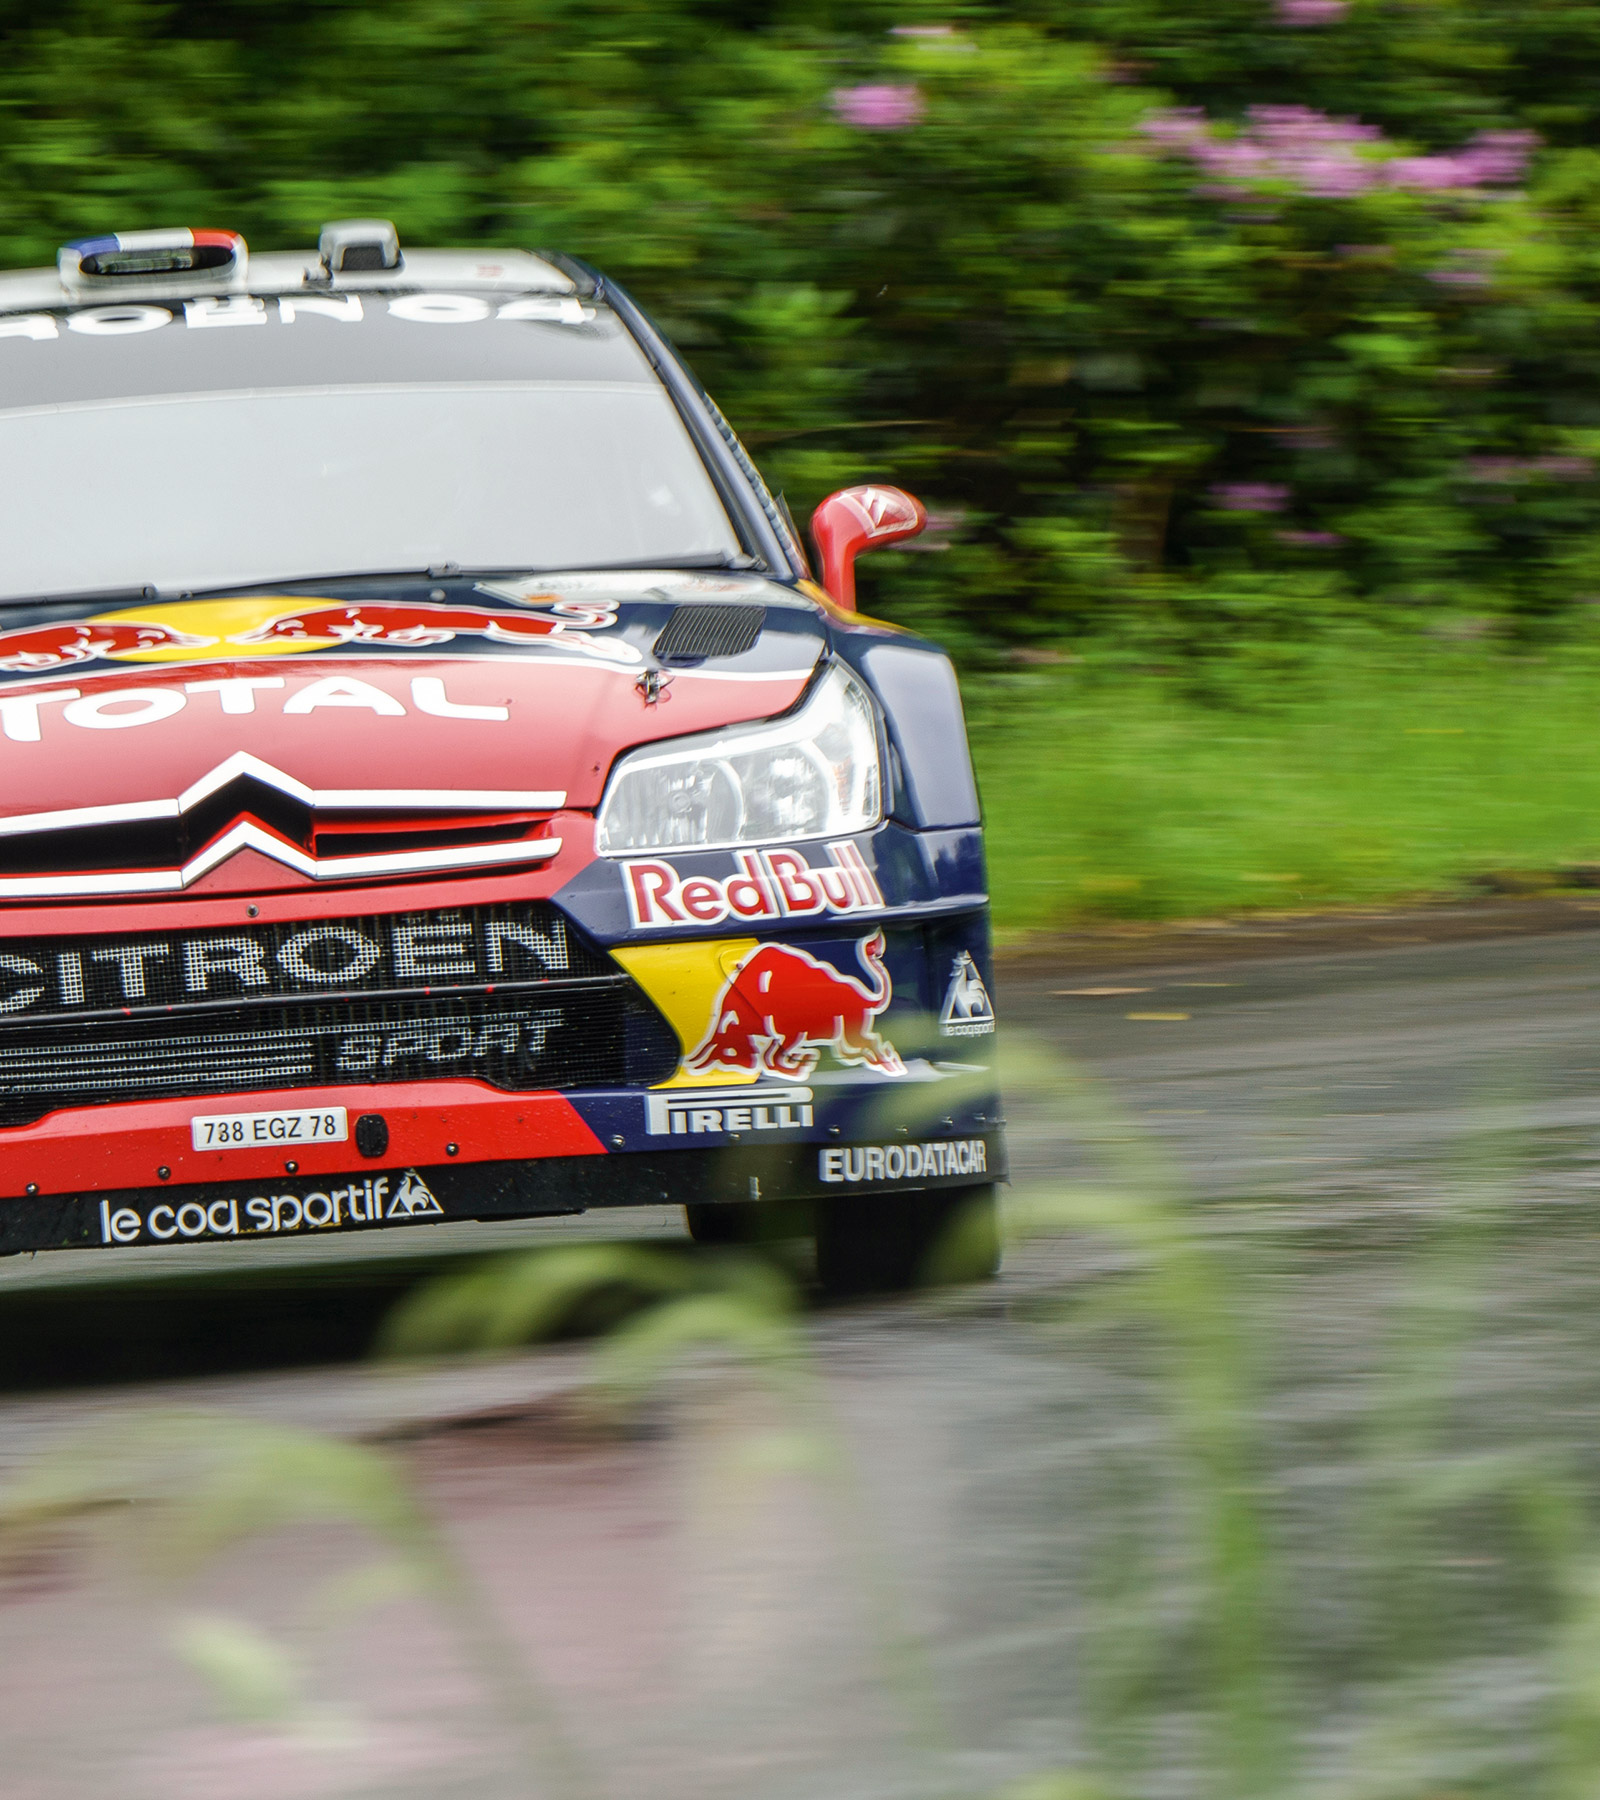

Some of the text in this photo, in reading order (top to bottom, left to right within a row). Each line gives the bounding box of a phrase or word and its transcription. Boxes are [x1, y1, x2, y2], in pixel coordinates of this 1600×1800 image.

[387, 293, 597, 325] C4
[336, 1017, 565, 1070] SPORT
[204, 1114, 336, 1144] 738 EGZ 78
[645, 1087, 814, 1135] PIRELLI
[819, 1139, 987, 1183] EURODATACAR
[100, 1177, 388, 1243] le coq sportif
